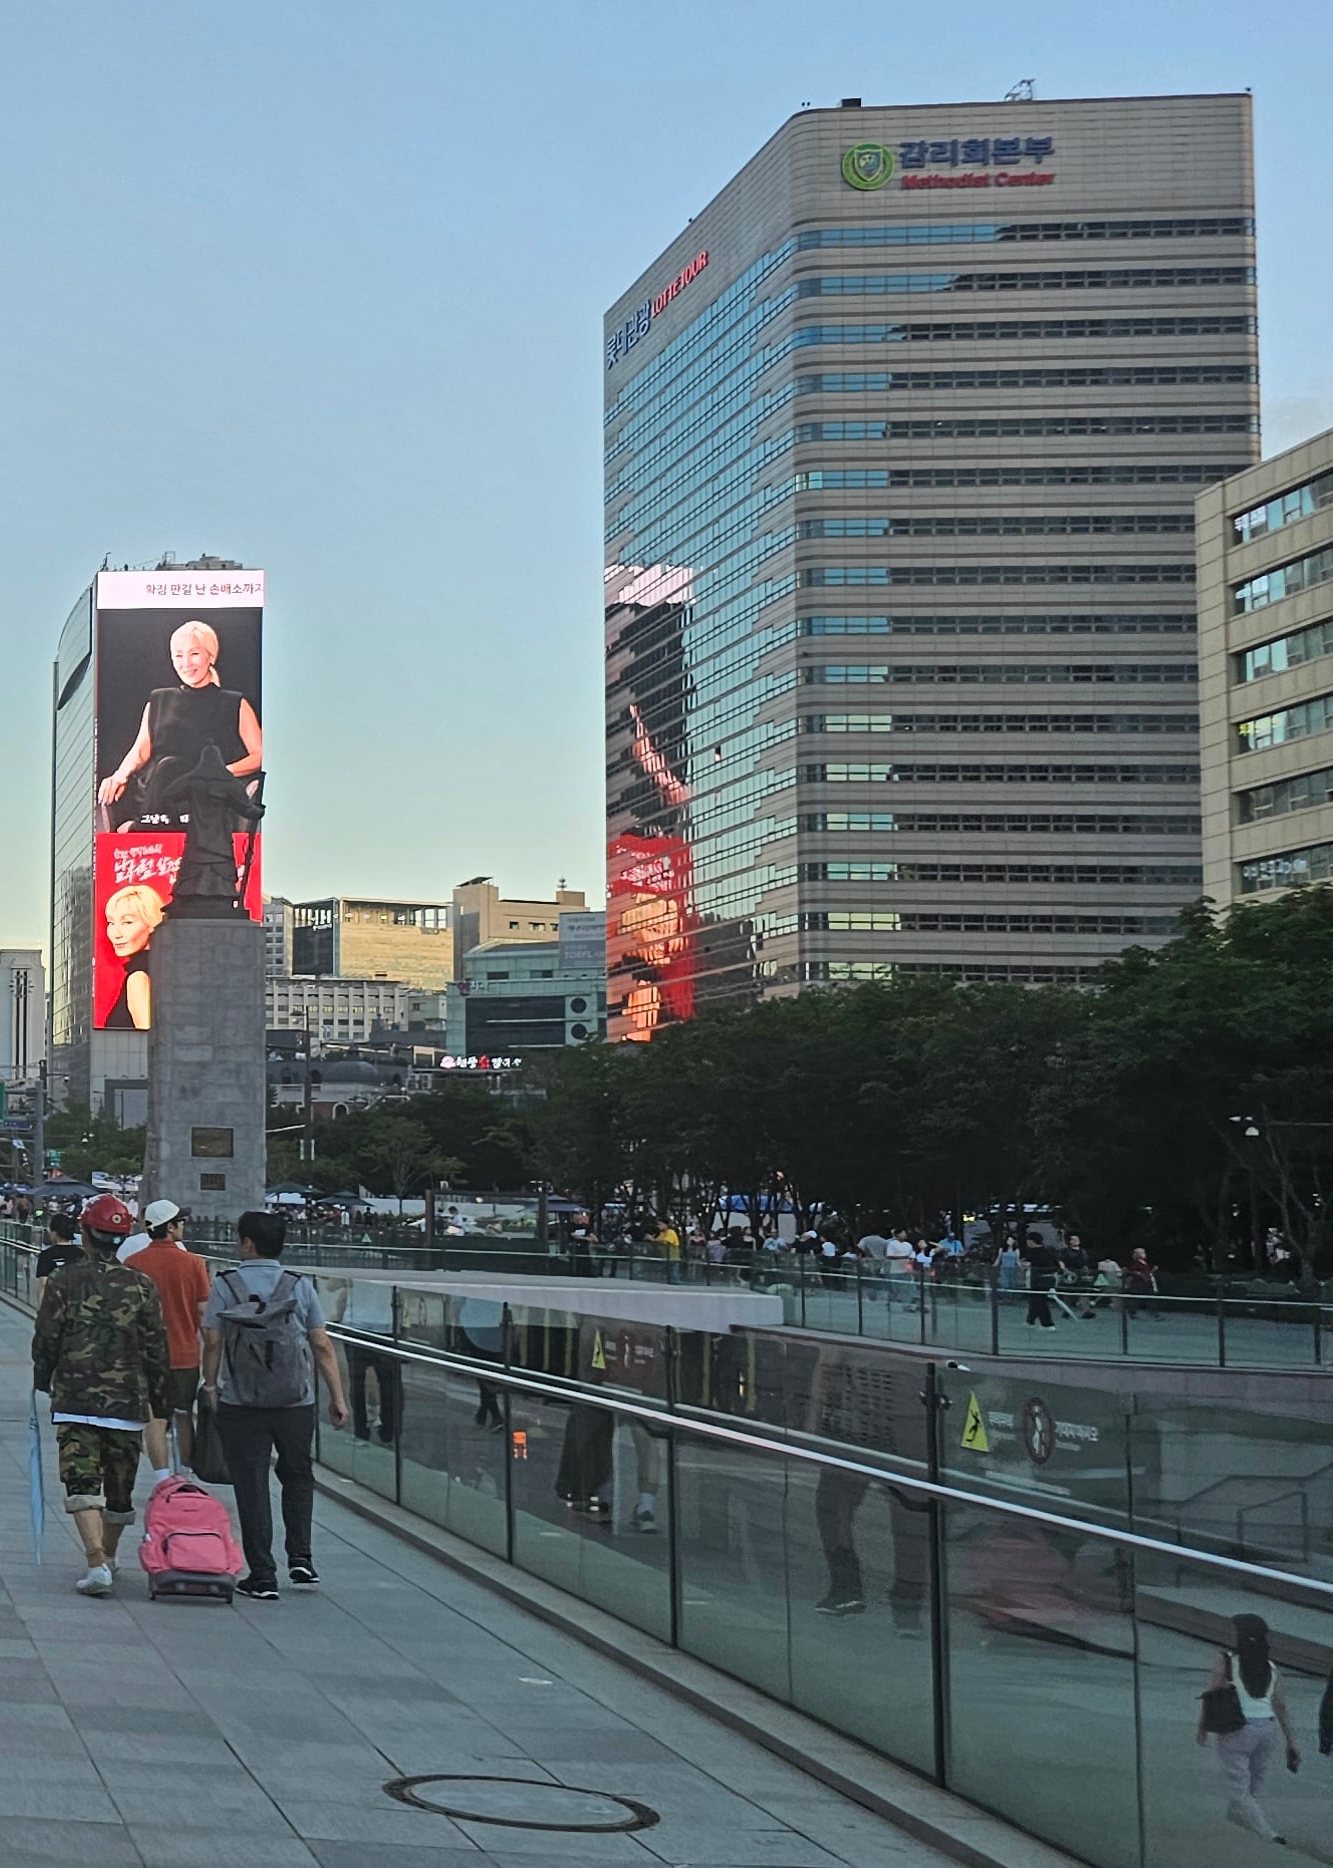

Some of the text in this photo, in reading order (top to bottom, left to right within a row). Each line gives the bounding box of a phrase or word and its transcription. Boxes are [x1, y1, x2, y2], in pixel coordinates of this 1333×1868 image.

[899, 137, 1056, 169] 감리회본부
[901, 171, 1056, 189] Methodist Center
[606, 299, 652, 370] 롯데관광
[195, 584, 206, 596] 난
